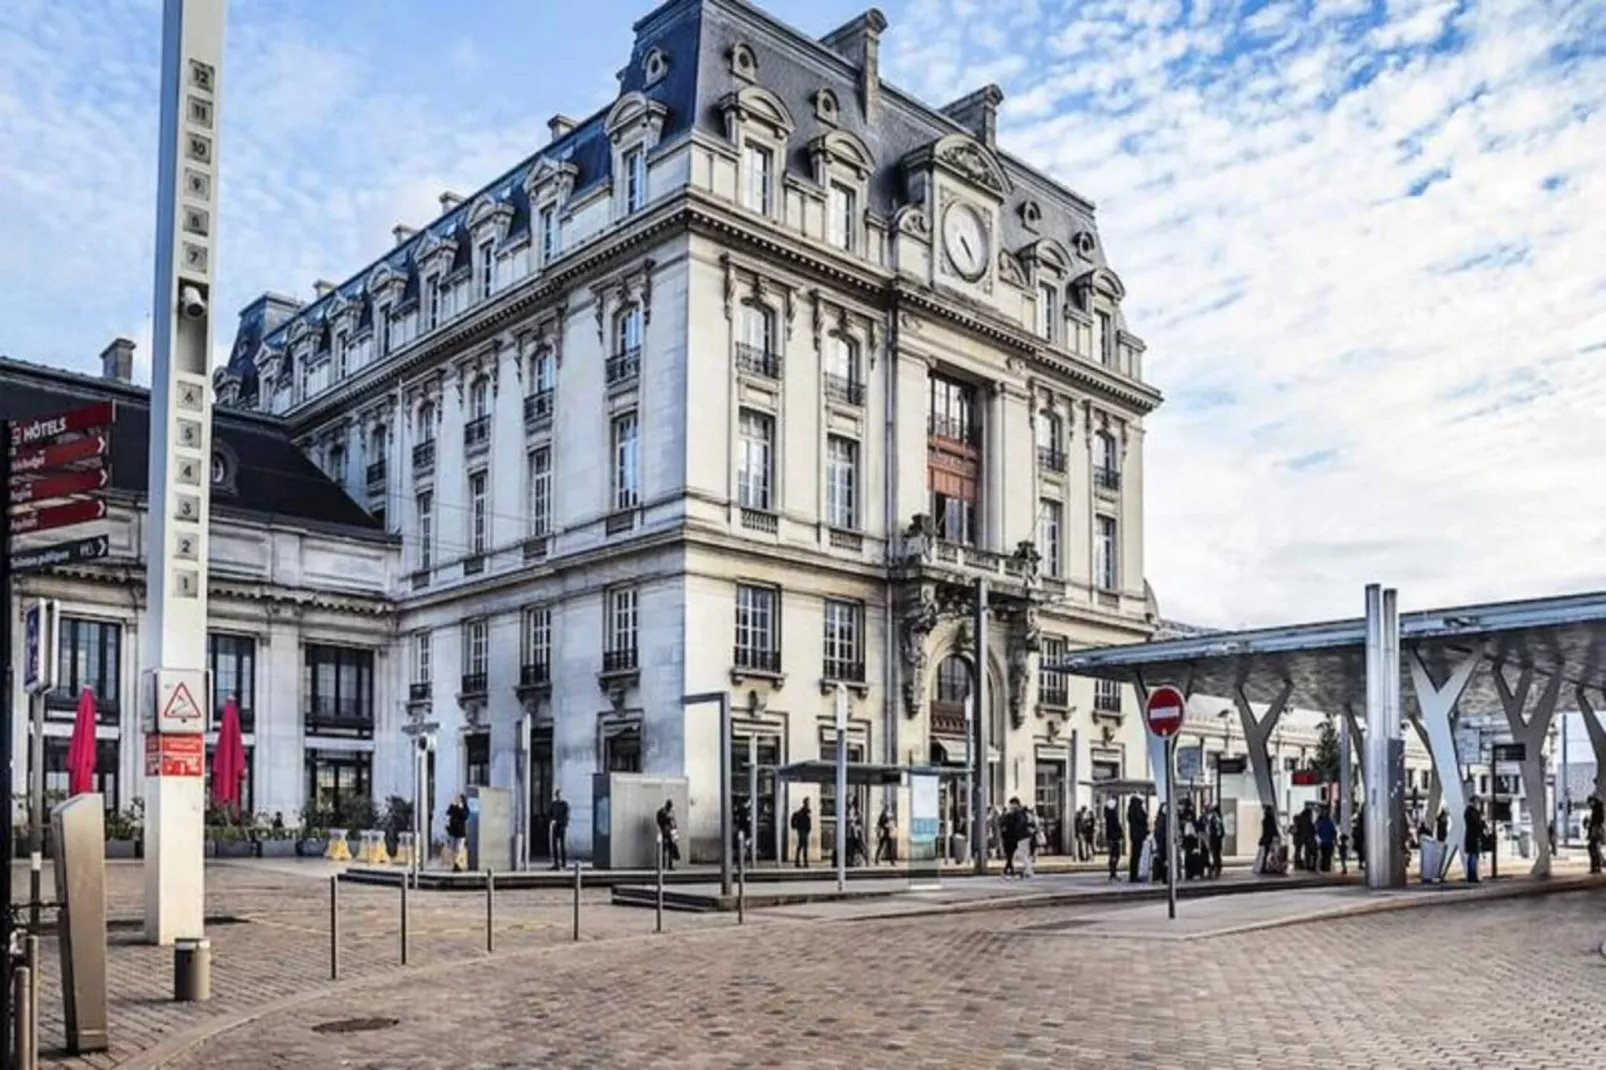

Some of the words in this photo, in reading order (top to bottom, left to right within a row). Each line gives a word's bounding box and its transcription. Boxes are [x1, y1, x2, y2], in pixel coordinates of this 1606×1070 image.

[23, 416, 68, 442] HÔTELS
[182, 501, 192, 515] 3
[181, 539, 191, 553] 2
